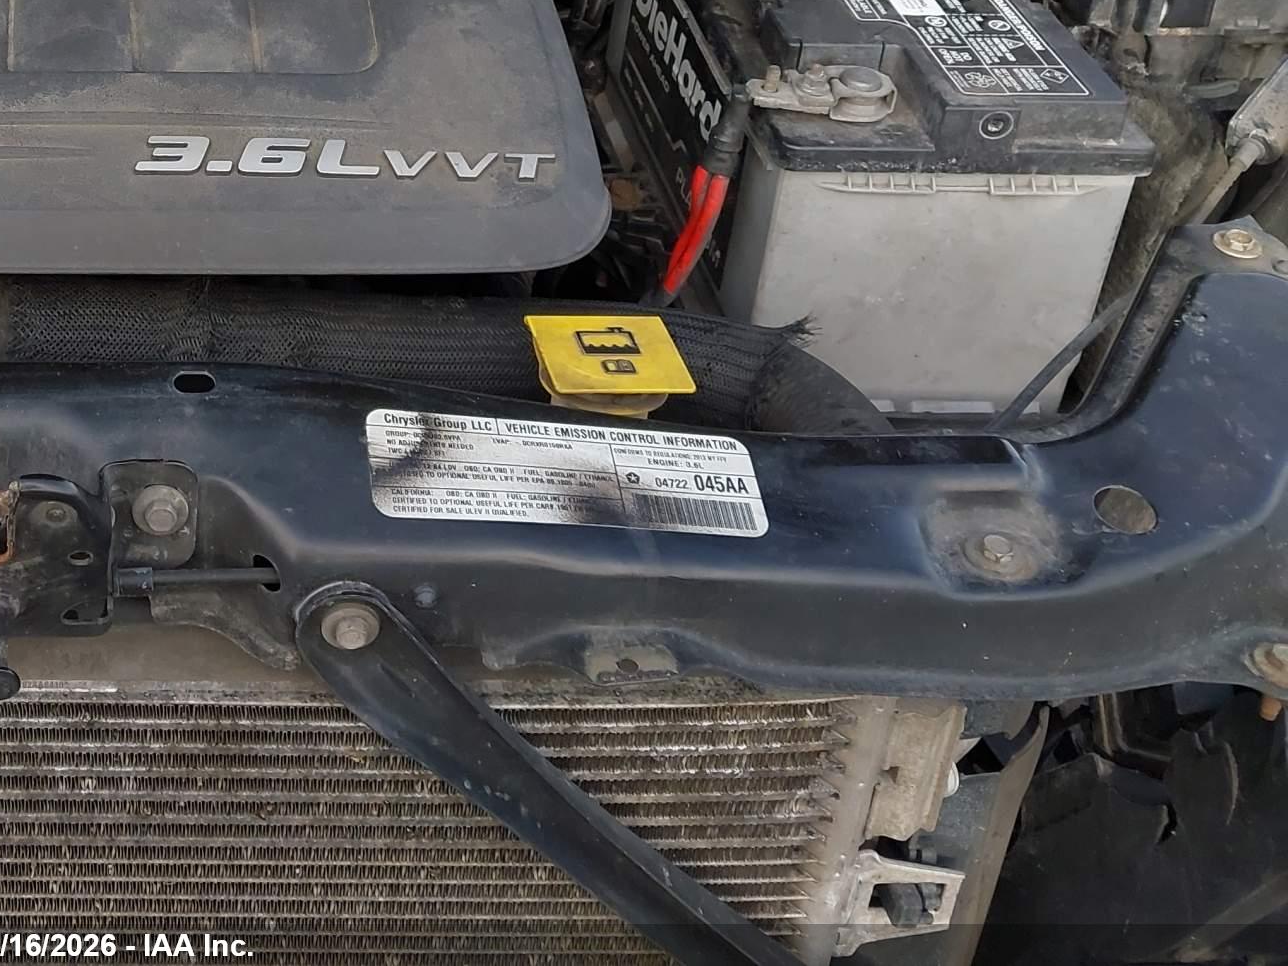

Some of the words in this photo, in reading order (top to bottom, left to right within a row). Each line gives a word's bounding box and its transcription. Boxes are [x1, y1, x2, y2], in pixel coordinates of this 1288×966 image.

[134, 135, 380, 179] 3.6L
[384, 150, 557, 182] VVT
[383, 413, 430, 427] Chrysler
[433, 417, 467, 431] Group
[471, 420, 492, 431] LLC
[504, 422, 550, 436] VEHICLE
[553, 426, 606, 441] EMISSION
[609, 431, 660, 445] CONTROL
[663, 436, 738, 451] INFORMATION
[448, 442, 474, 450] NEEDED
[613, 447, 644, 456] CONFORMS
[647, 458, 683, 468] ENGINE:
[685, 461, 704, 470] 3.6L
[472, 474, 497, 482] USEFUL
[544, 471, 577, 479] GASOLINE
[694, 474, 749, 494] 045AA
[392, 497, 427, 505] CERTIFIED
[528, 494, 561, 502] GASOLINE
